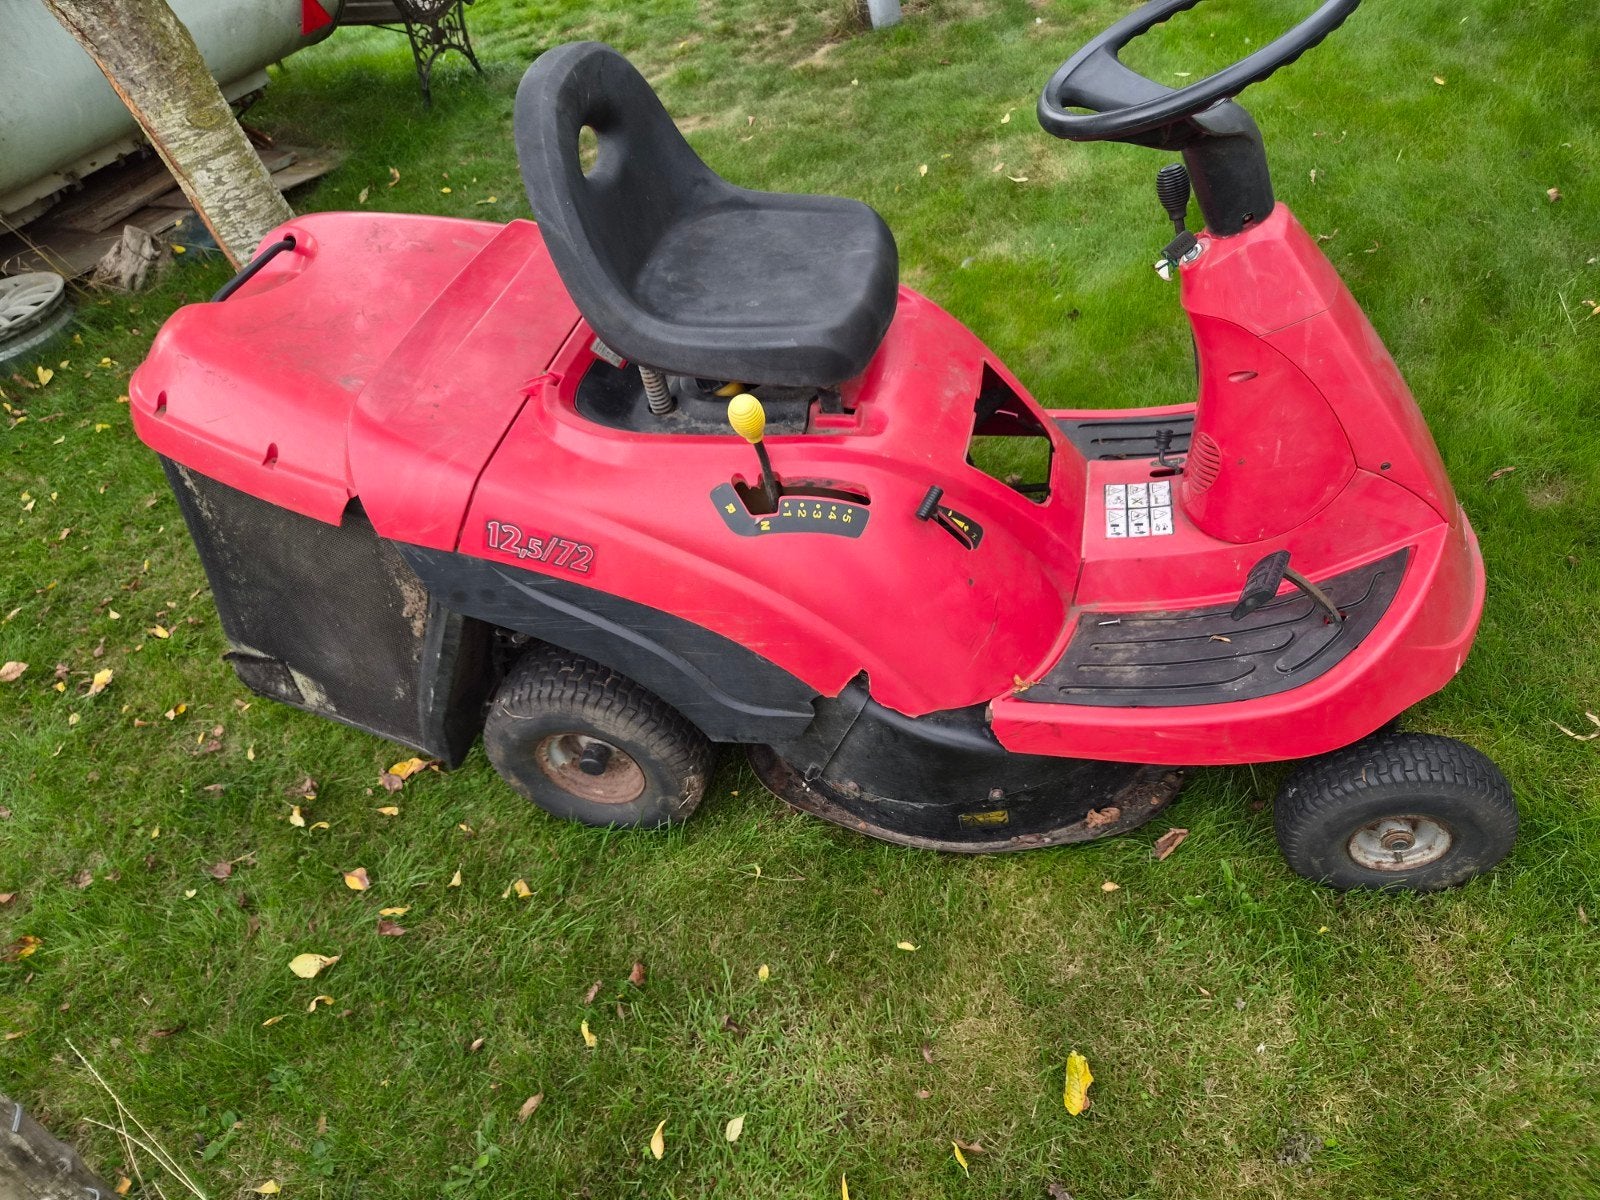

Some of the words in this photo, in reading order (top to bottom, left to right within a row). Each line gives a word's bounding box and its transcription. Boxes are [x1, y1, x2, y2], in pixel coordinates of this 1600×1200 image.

[797, 509, 807, 518] 2
[812, 510, 822, 519] 3
[828, 511, 837, 520] 4
[842, 513, 852, 523] 5
[486, 520, 594, 572] 12,5/72
